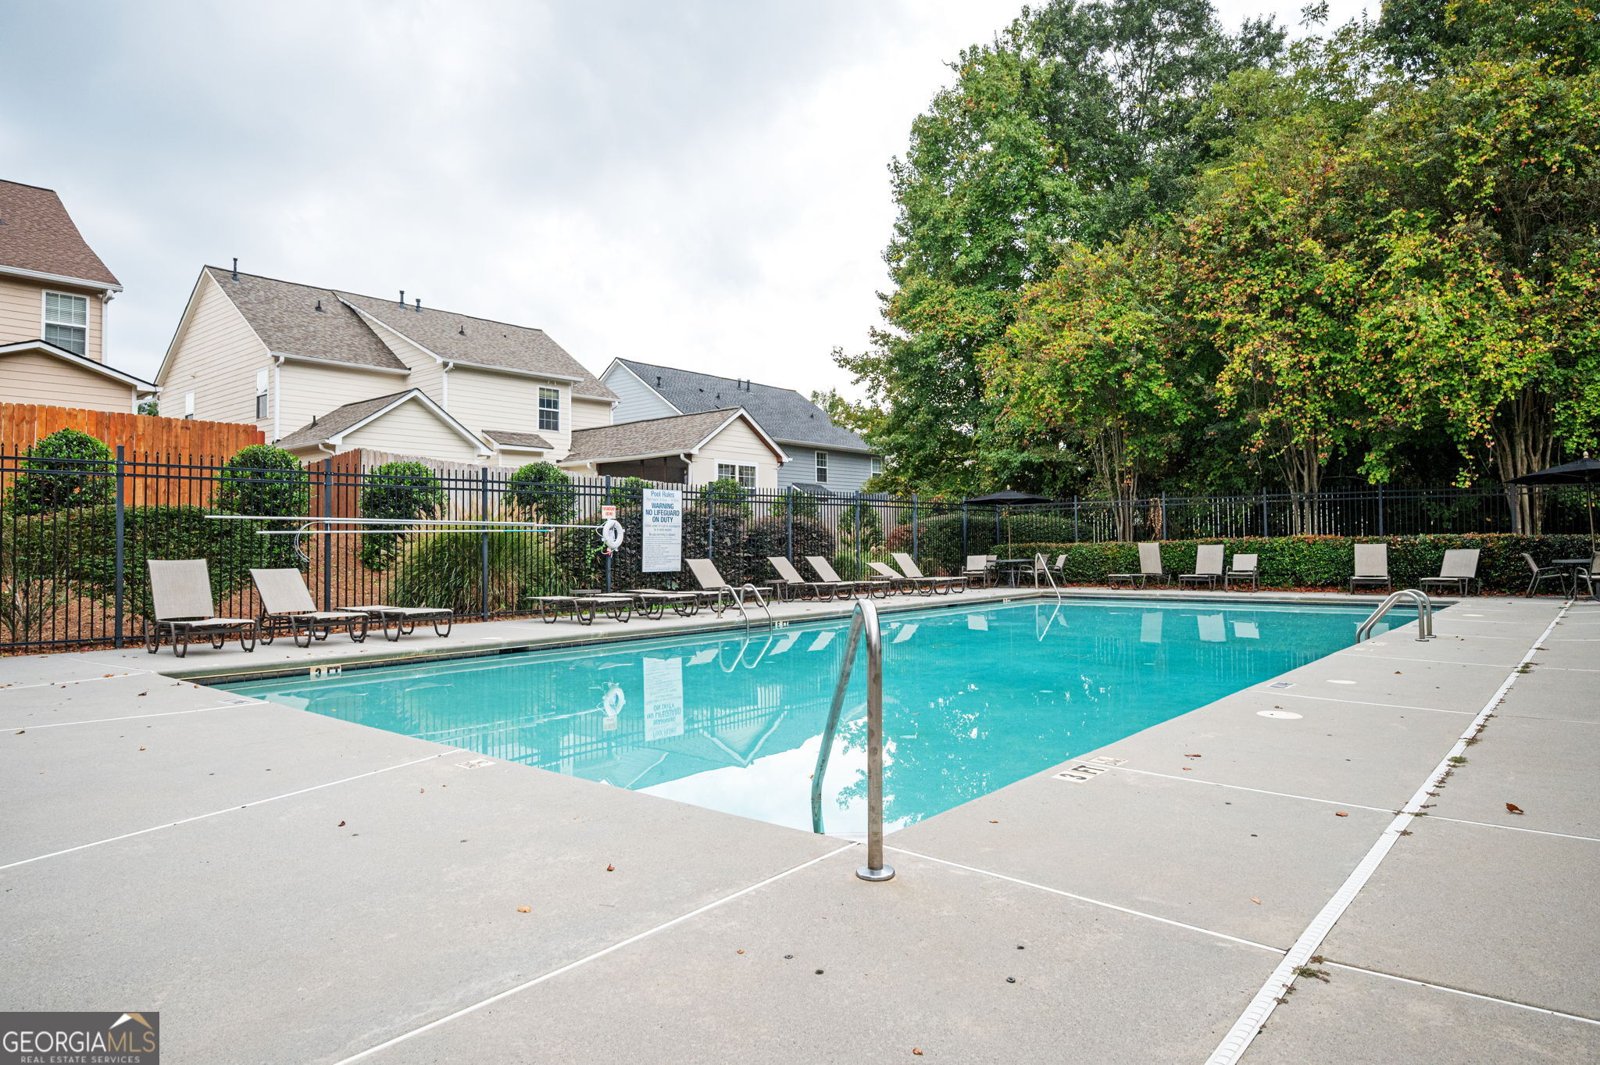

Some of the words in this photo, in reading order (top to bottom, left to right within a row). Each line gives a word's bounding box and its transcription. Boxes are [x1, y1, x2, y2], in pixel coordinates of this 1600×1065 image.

[650, 490, 661, 498] Pool
[651, 502, 674, 510] WARNING
[654, 509, 680, 517] LIFEGUARD
